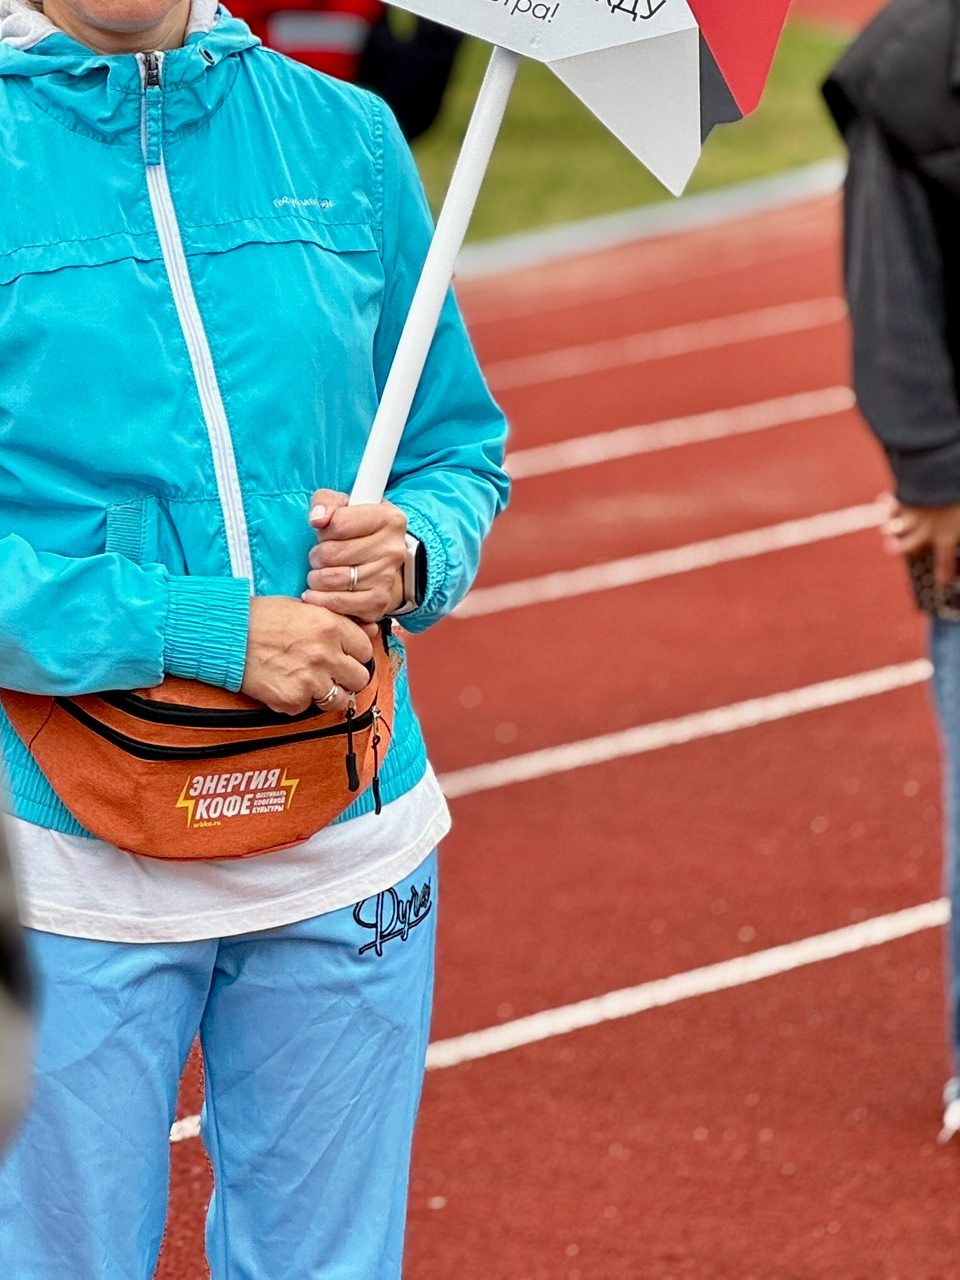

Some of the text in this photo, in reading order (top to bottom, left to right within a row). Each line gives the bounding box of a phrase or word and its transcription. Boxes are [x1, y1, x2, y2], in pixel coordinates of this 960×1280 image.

[189, 768, 281, 797] ЭНЕРГИЯ
[195, 793, 254, 820] КОФЕ
[251, 804, 284, 814] КУЛЬТУРЫ
